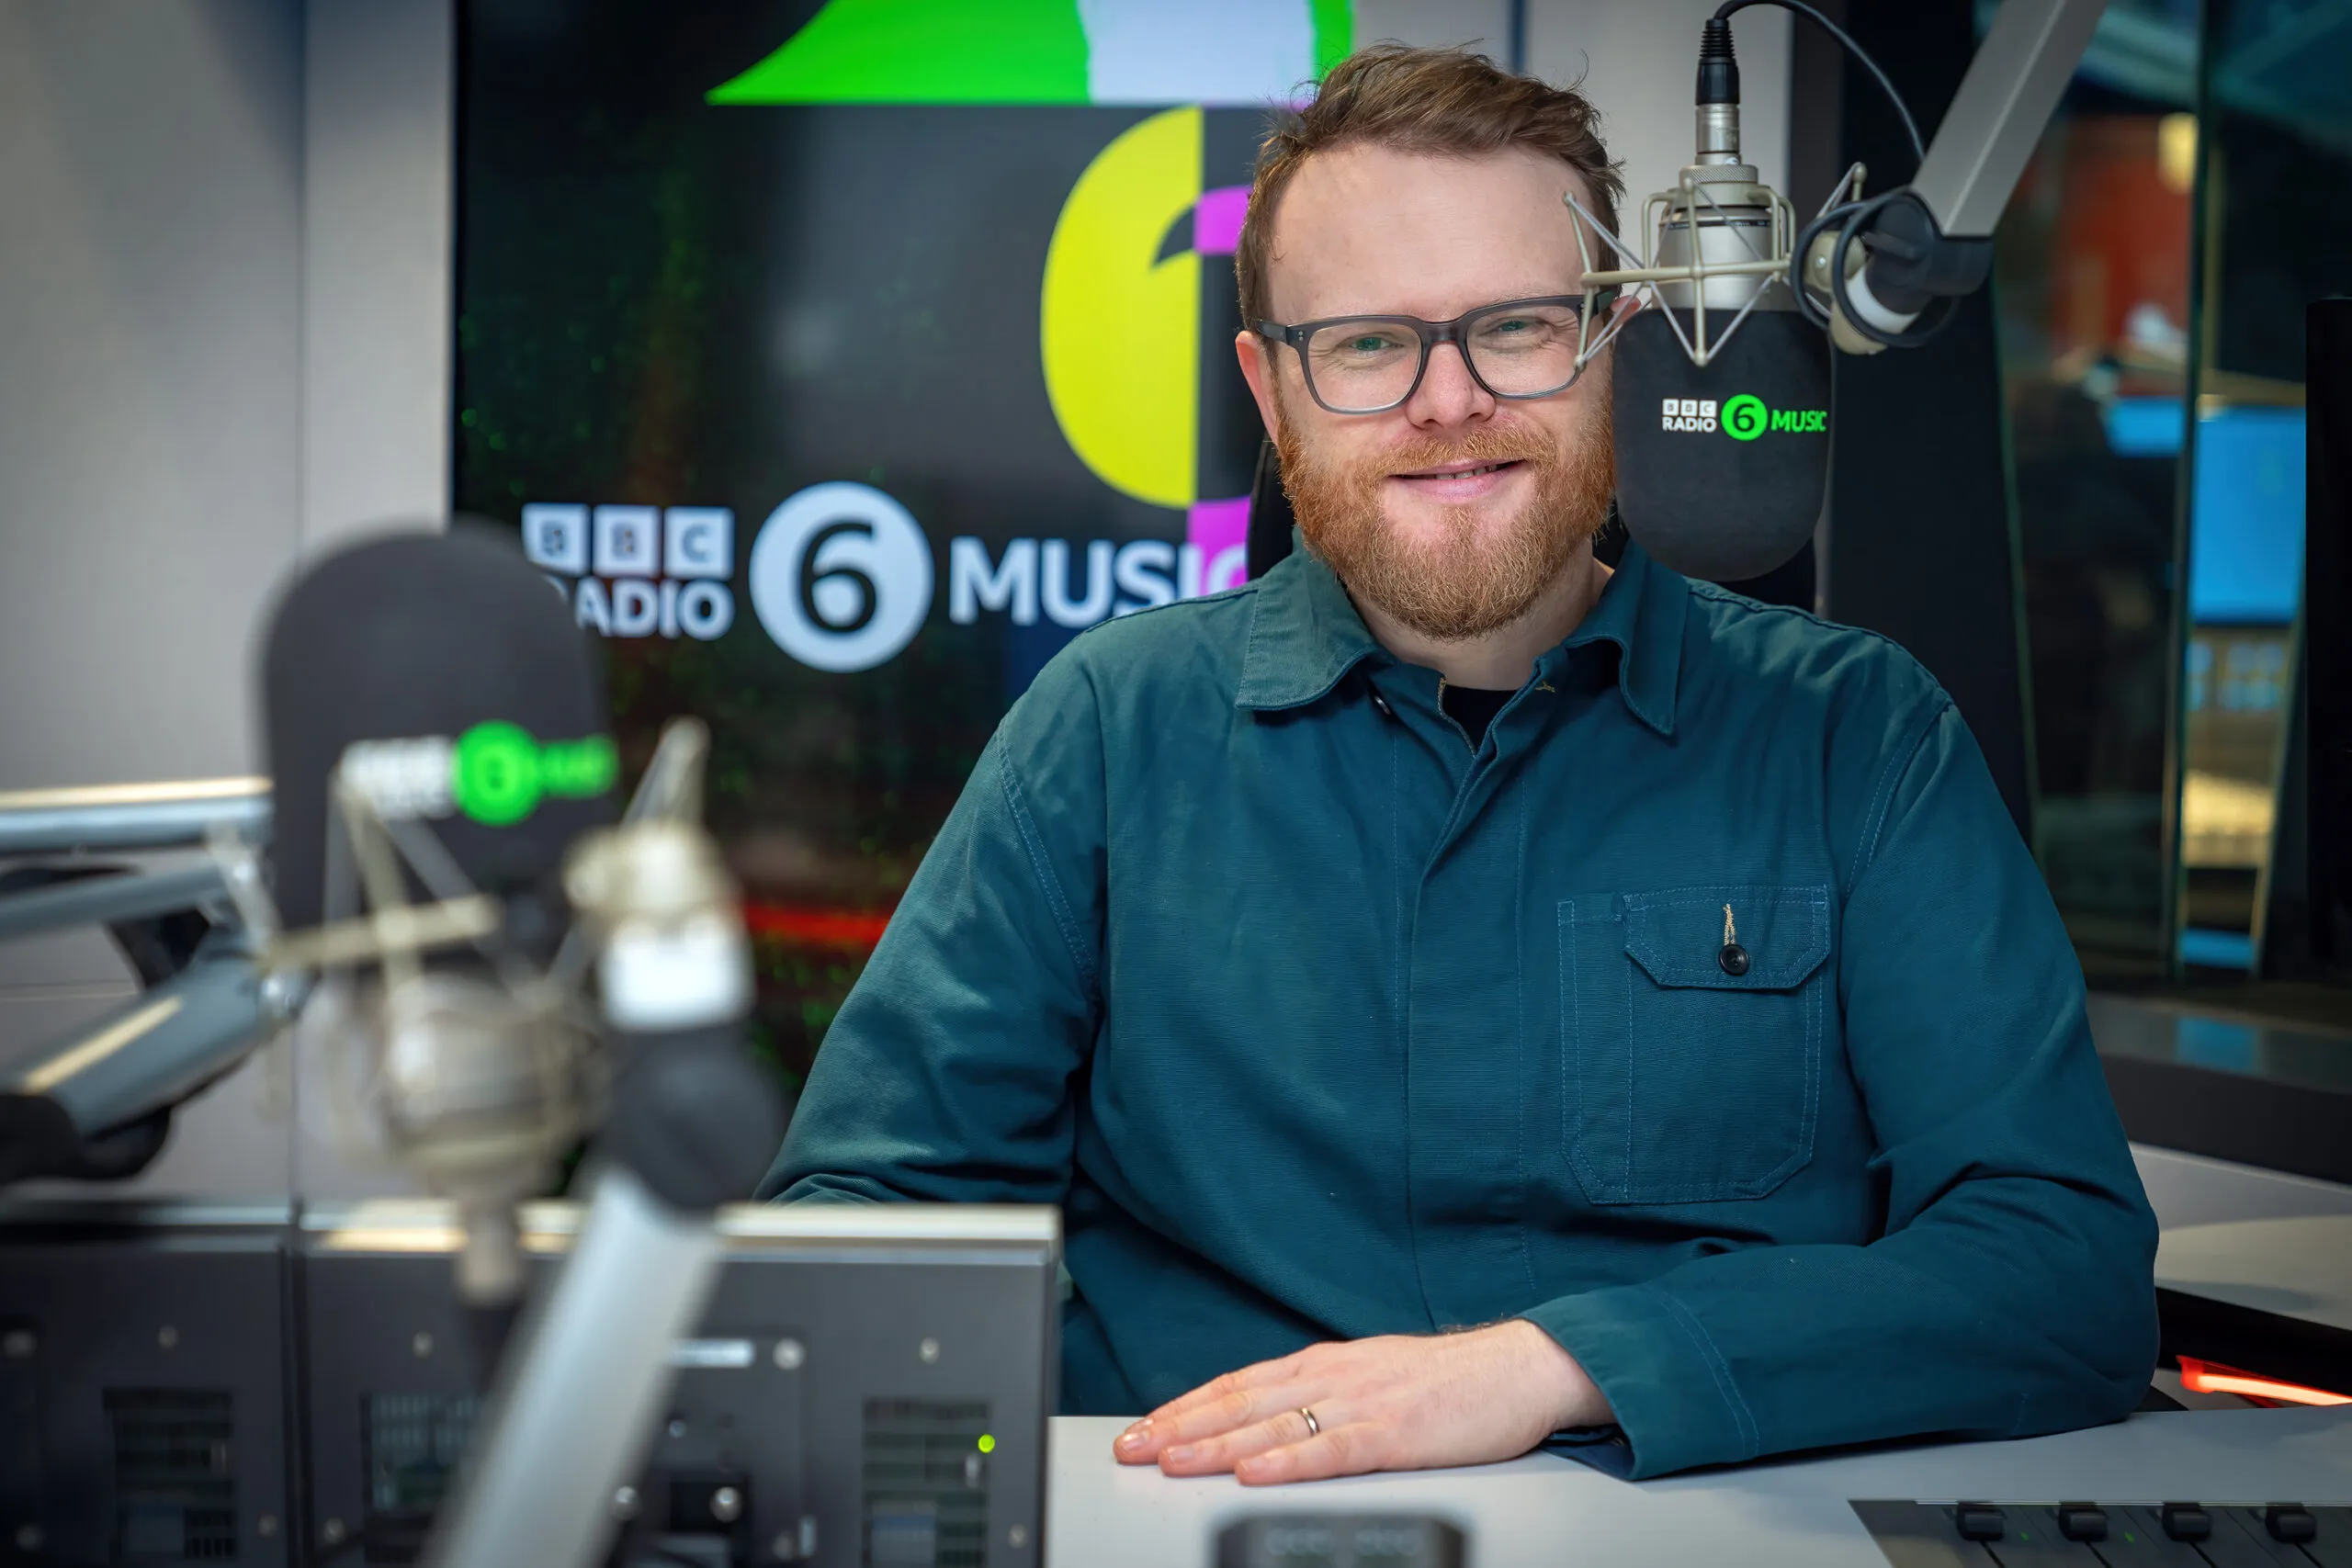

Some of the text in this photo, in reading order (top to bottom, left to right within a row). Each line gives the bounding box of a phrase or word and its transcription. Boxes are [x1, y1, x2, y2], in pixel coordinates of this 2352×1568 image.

[1662, 402, 1827, 433] RADIO 6 MUSIC
[1664, 400, 1715, 416] BBC
[526, 506, 729, 570] BBC
[544, 575, 734, 641] ADIO
[798, 518, 878, 635] 6
